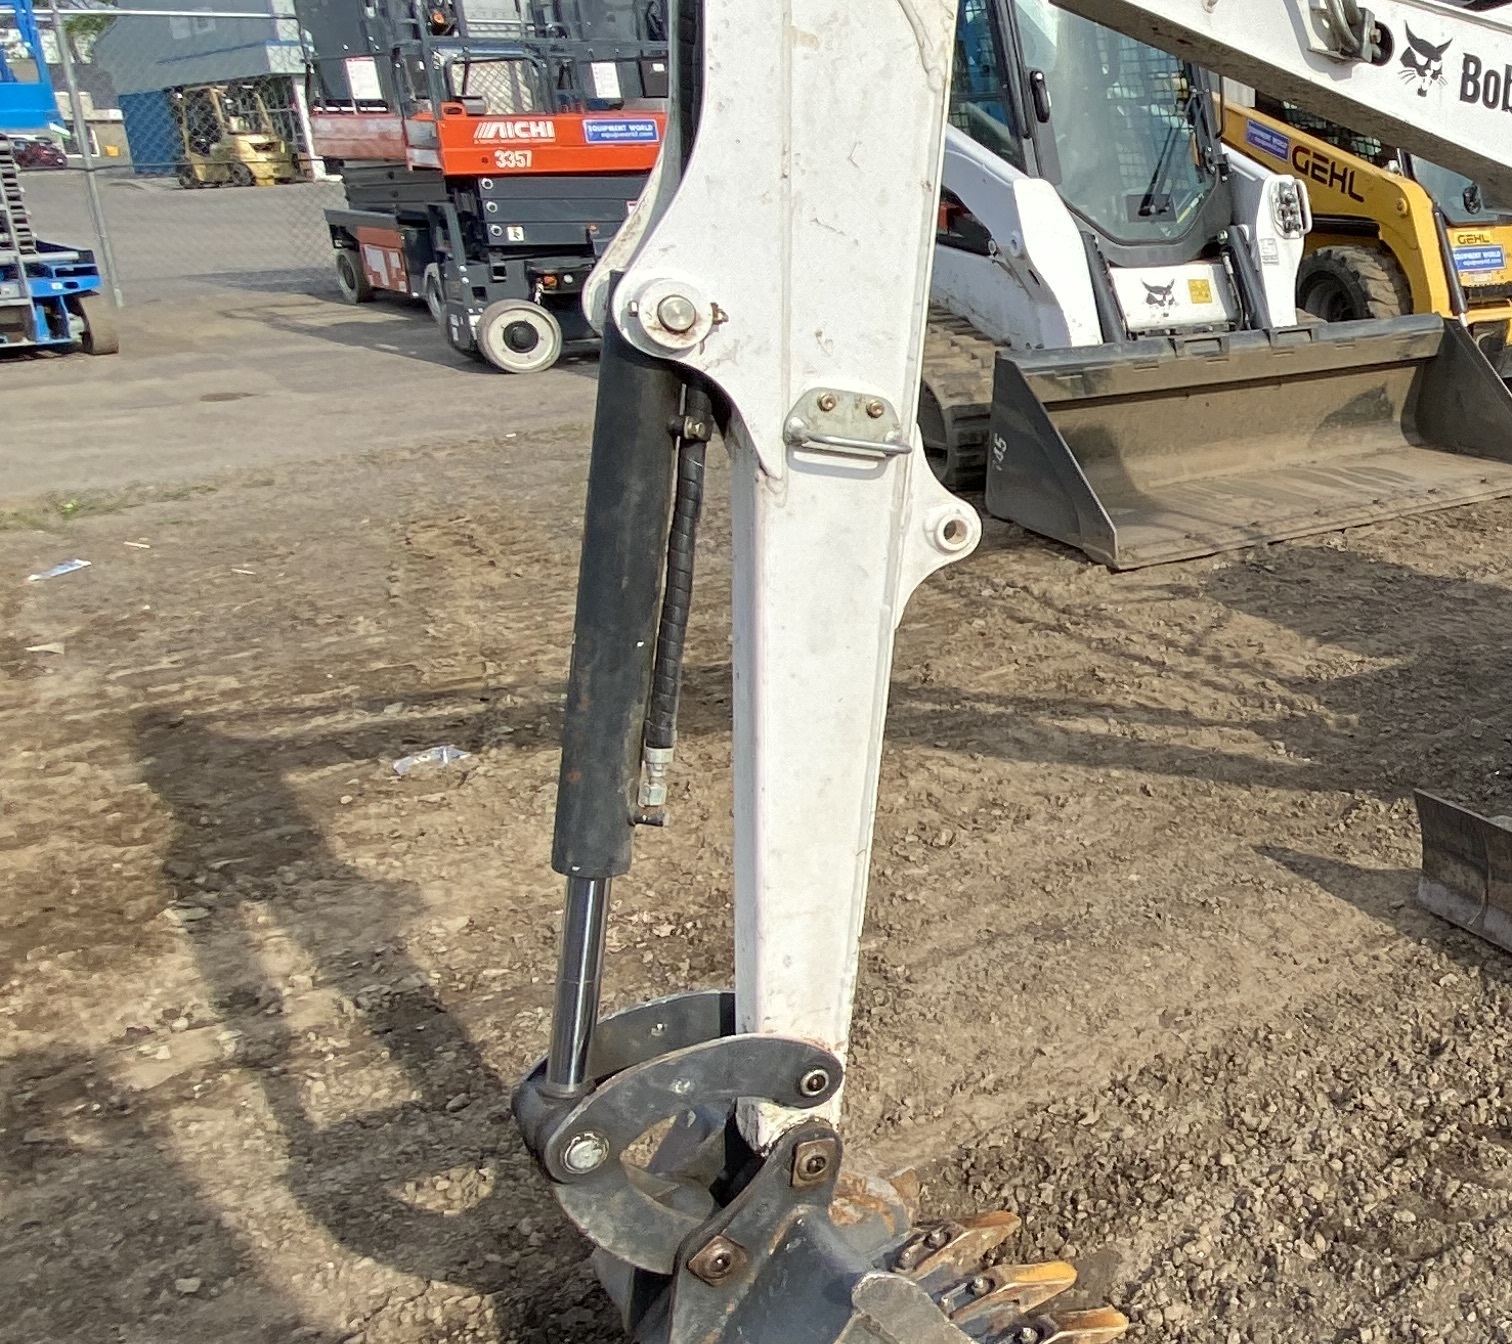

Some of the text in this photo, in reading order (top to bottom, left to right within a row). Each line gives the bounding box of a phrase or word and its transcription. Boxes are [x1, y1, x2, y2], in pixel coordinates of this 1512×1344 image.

[474, 121, 556, 139] AICHI
[588, 124, 654, 132] EQUIPMENT WORLD
[493, 149, 533, 169] 3357
[1291, 145, 1364, 203] GEHL
[1457, 234, 1490, 244] GEHL
[1454, 252, 1482, 261] QUIPMENT
